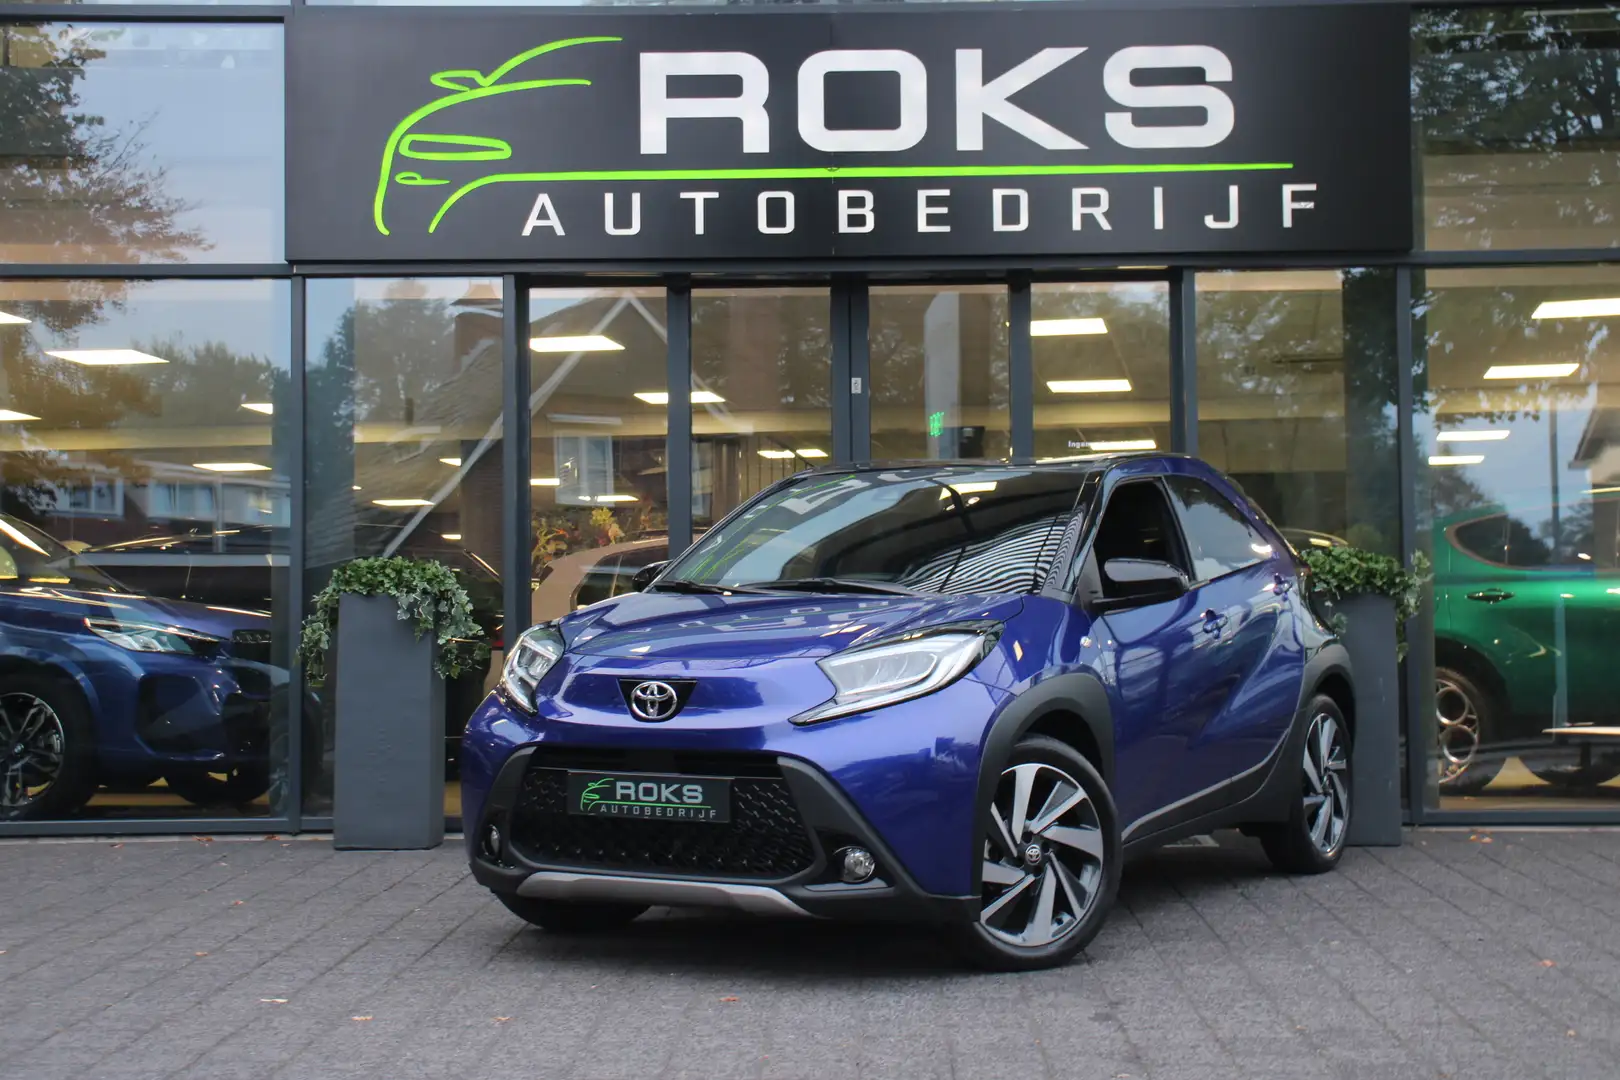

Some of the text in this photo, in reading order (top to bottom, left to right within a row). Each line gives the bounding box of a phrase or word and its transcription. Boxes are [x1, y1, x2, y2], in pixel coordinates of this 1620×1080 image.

[639, 45, 1235, 155] ROKS
[521, 183, 1317, 237] AUTOBEDRIJF
[600, 804, 716, 819] AUTOBEDRIJF
[615, 781, 703, 804] ROKS
